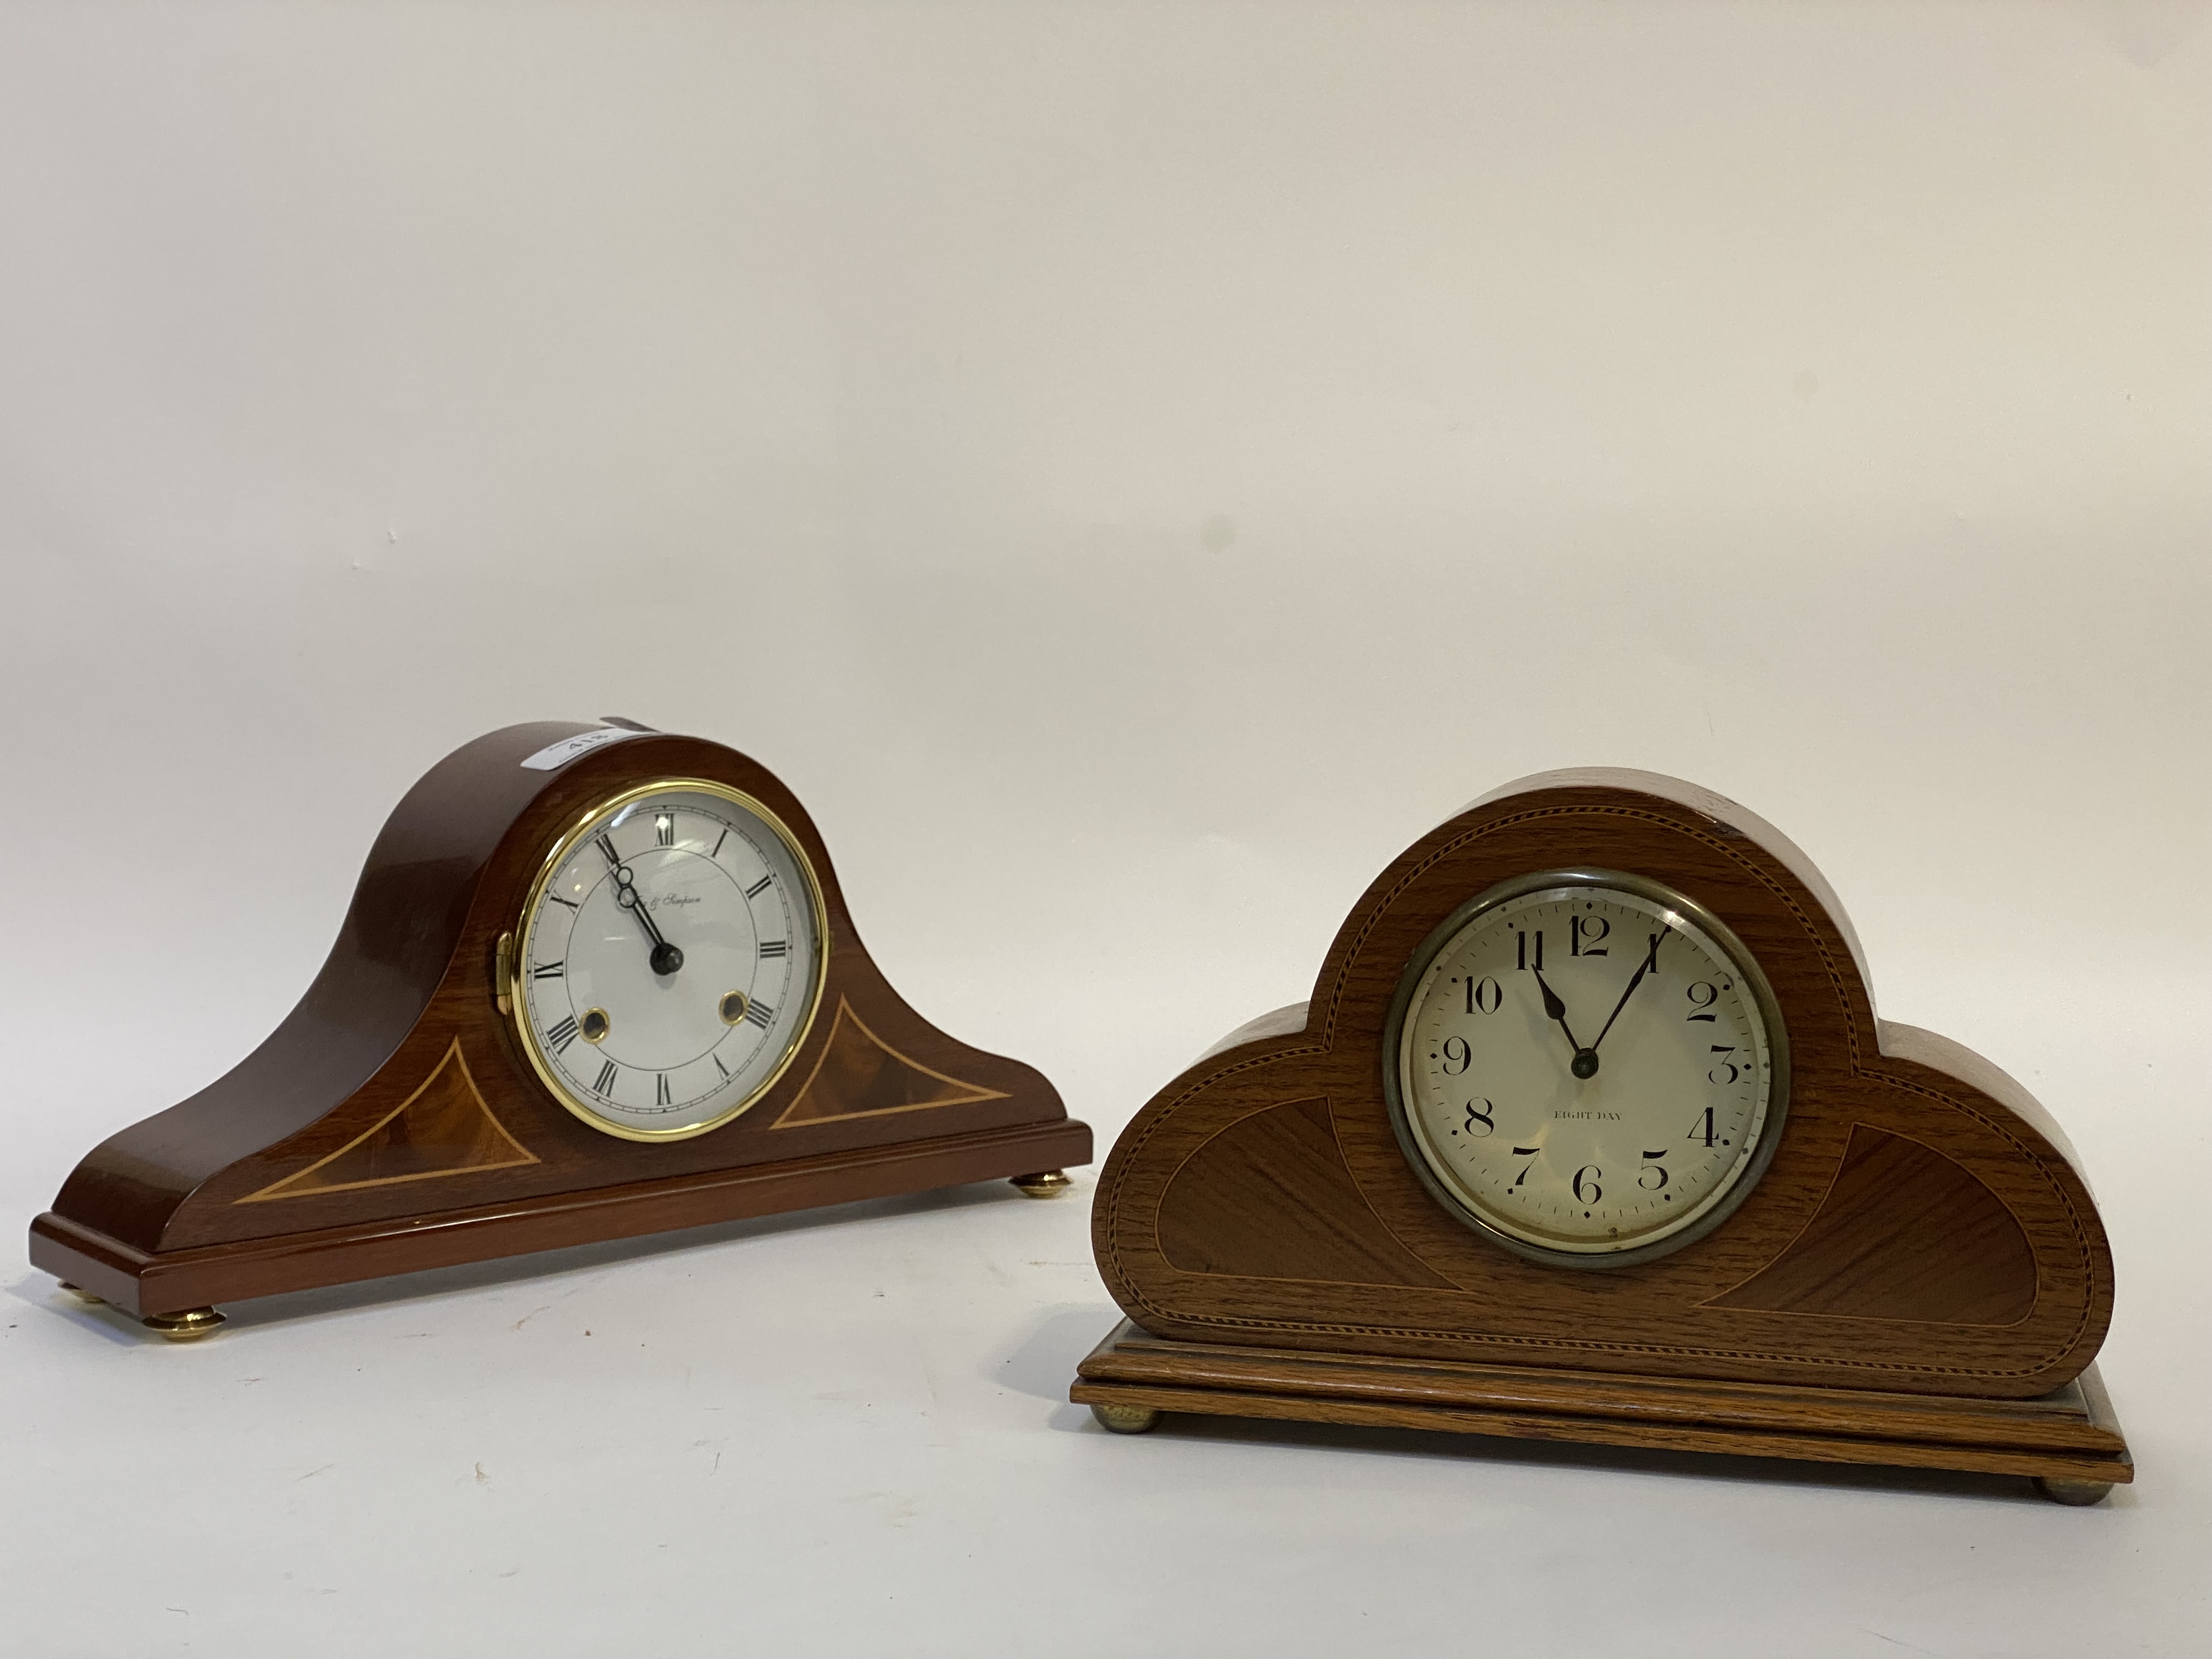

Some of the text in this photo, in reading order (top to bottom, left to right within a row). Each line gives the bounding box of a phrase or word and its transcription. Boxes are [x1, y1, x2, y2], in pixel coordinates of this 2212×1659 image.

[654, 813, 674, 847] XII
[712, 828, 729, 858] I
[549, 889, 581, 916] X
[744, 873, 772, 901] II
[759, 940, 786, 960] III
[1515, 930, 1545, 972] 11
[1570, 915, 1611, 957] 12
[1647, 933, 1660, 974] 1
[534, 960, 565, 982] IX
[1464, 975, 1503, 1015] 10
[1686, 980, 1719, 1023] 2
[545, 1013, 580, 1056] VIII
[712, 1052, 730, 1081] V
[1442, 1036, 1472, 1076] 9
[1708, 1045, 1739, 1085] 3
[591, 1058, 618, 1098] VII
[656, 1073, 672, 1106] VI
[1464, 1097, 1495, 1138] 8
[1554, 1110, 1623, 1121] EIGHT DAY
[1686, 1107, 1719, 1148] 4
[1512, 1146, 1541, 1186] 7
[1572, 1165, 1602, 1205] 6
[1638, 1149, 1669, 1190] 5
